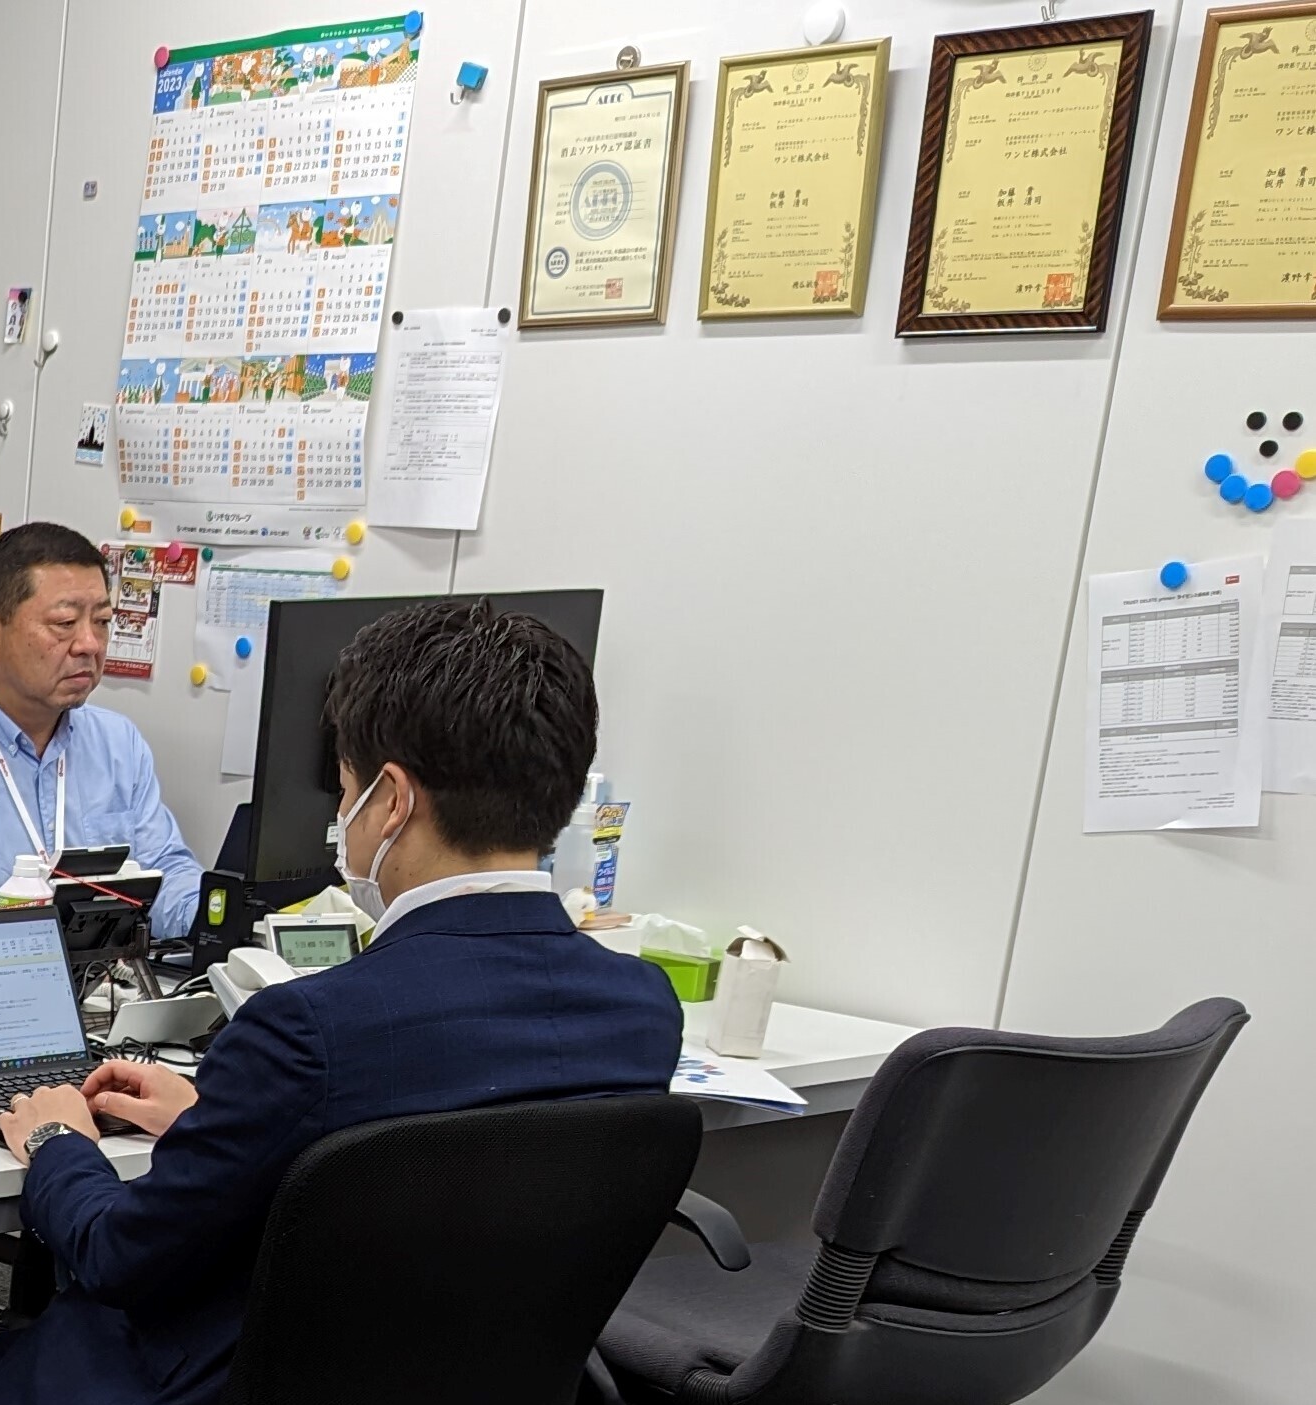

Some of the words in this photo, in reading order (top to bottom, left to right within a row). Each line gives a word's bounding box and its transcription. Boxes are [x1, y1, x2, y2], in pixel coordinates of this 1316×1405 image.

[157, 77, 182, 94] 2023
[342, 92, 347, 102] 4
[272, 100, 278, 110] 3
[209, 108, 214, 118] 2
[560, 138, 652, 158] 消去ソフトウェア認証書
[1004, 146, 1068, 160] ワンビ株式会社
[774, 152, 830, 164] ワンビ株式会社
[257, 255, 262, 265] 7
[323, 251, 329, 261] 8
[136, 263, 141, 273] 5
[194, 260, 199, 270] 6
[118, 406, 123, 416] 9
[176, 406, 184, 415] 10
[238, 405, 245, 415] 11
[302, 405, 310, 415] 12
